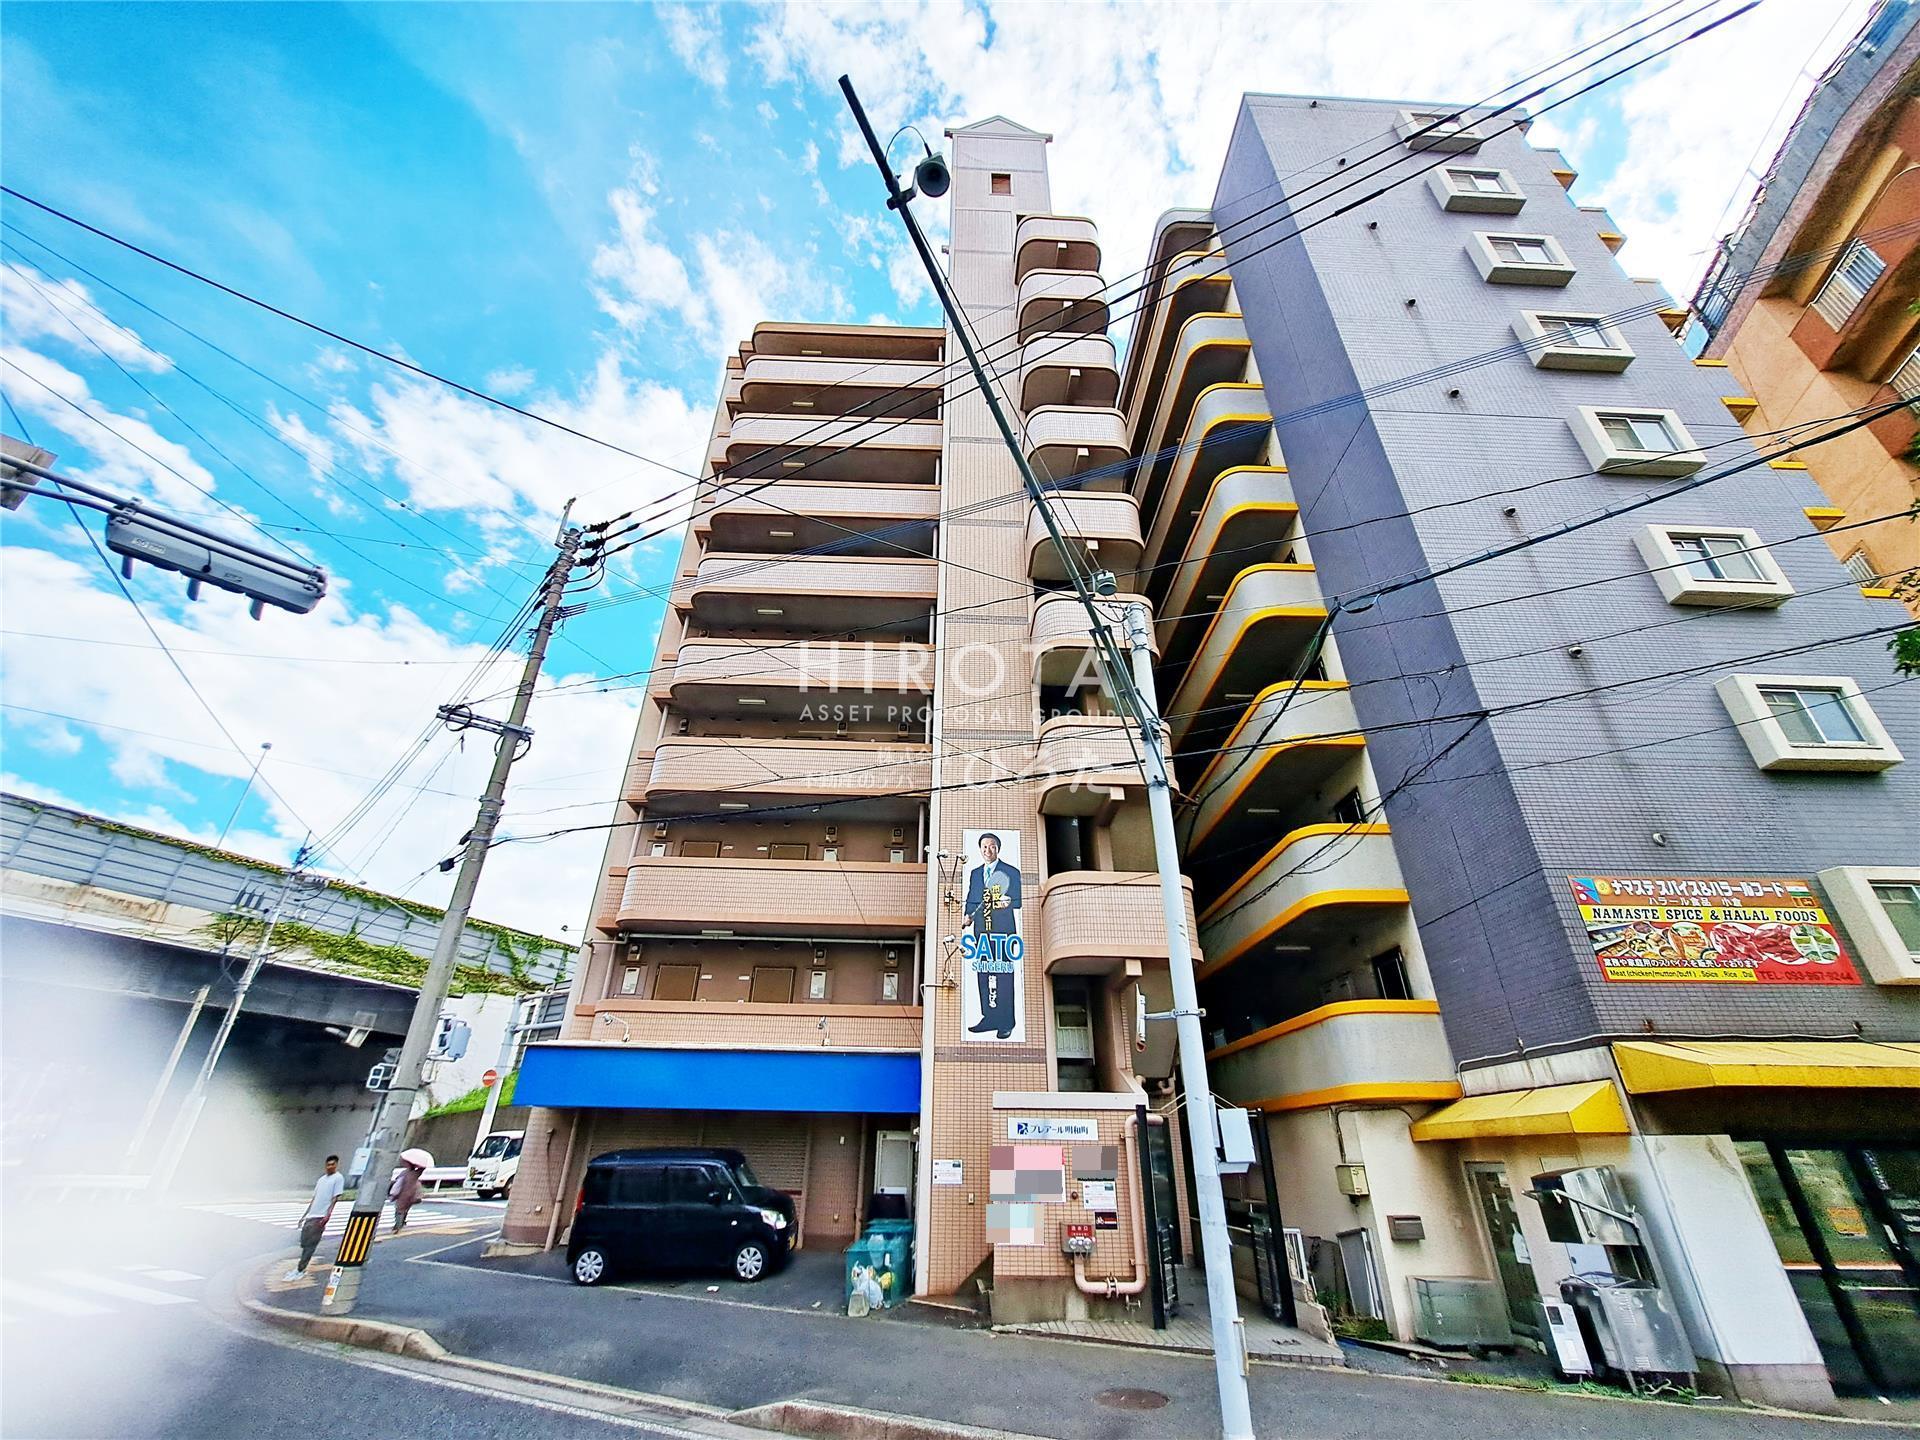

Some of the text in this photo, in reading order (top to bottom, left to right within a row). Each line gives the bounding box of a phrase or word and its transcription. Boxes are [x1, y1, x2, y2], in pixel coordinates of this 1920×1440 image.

[1592, 908, 1818, 922] NAMASTE SPICE & HALAL FOODS
[960, 934, 1024, 960] SATO
